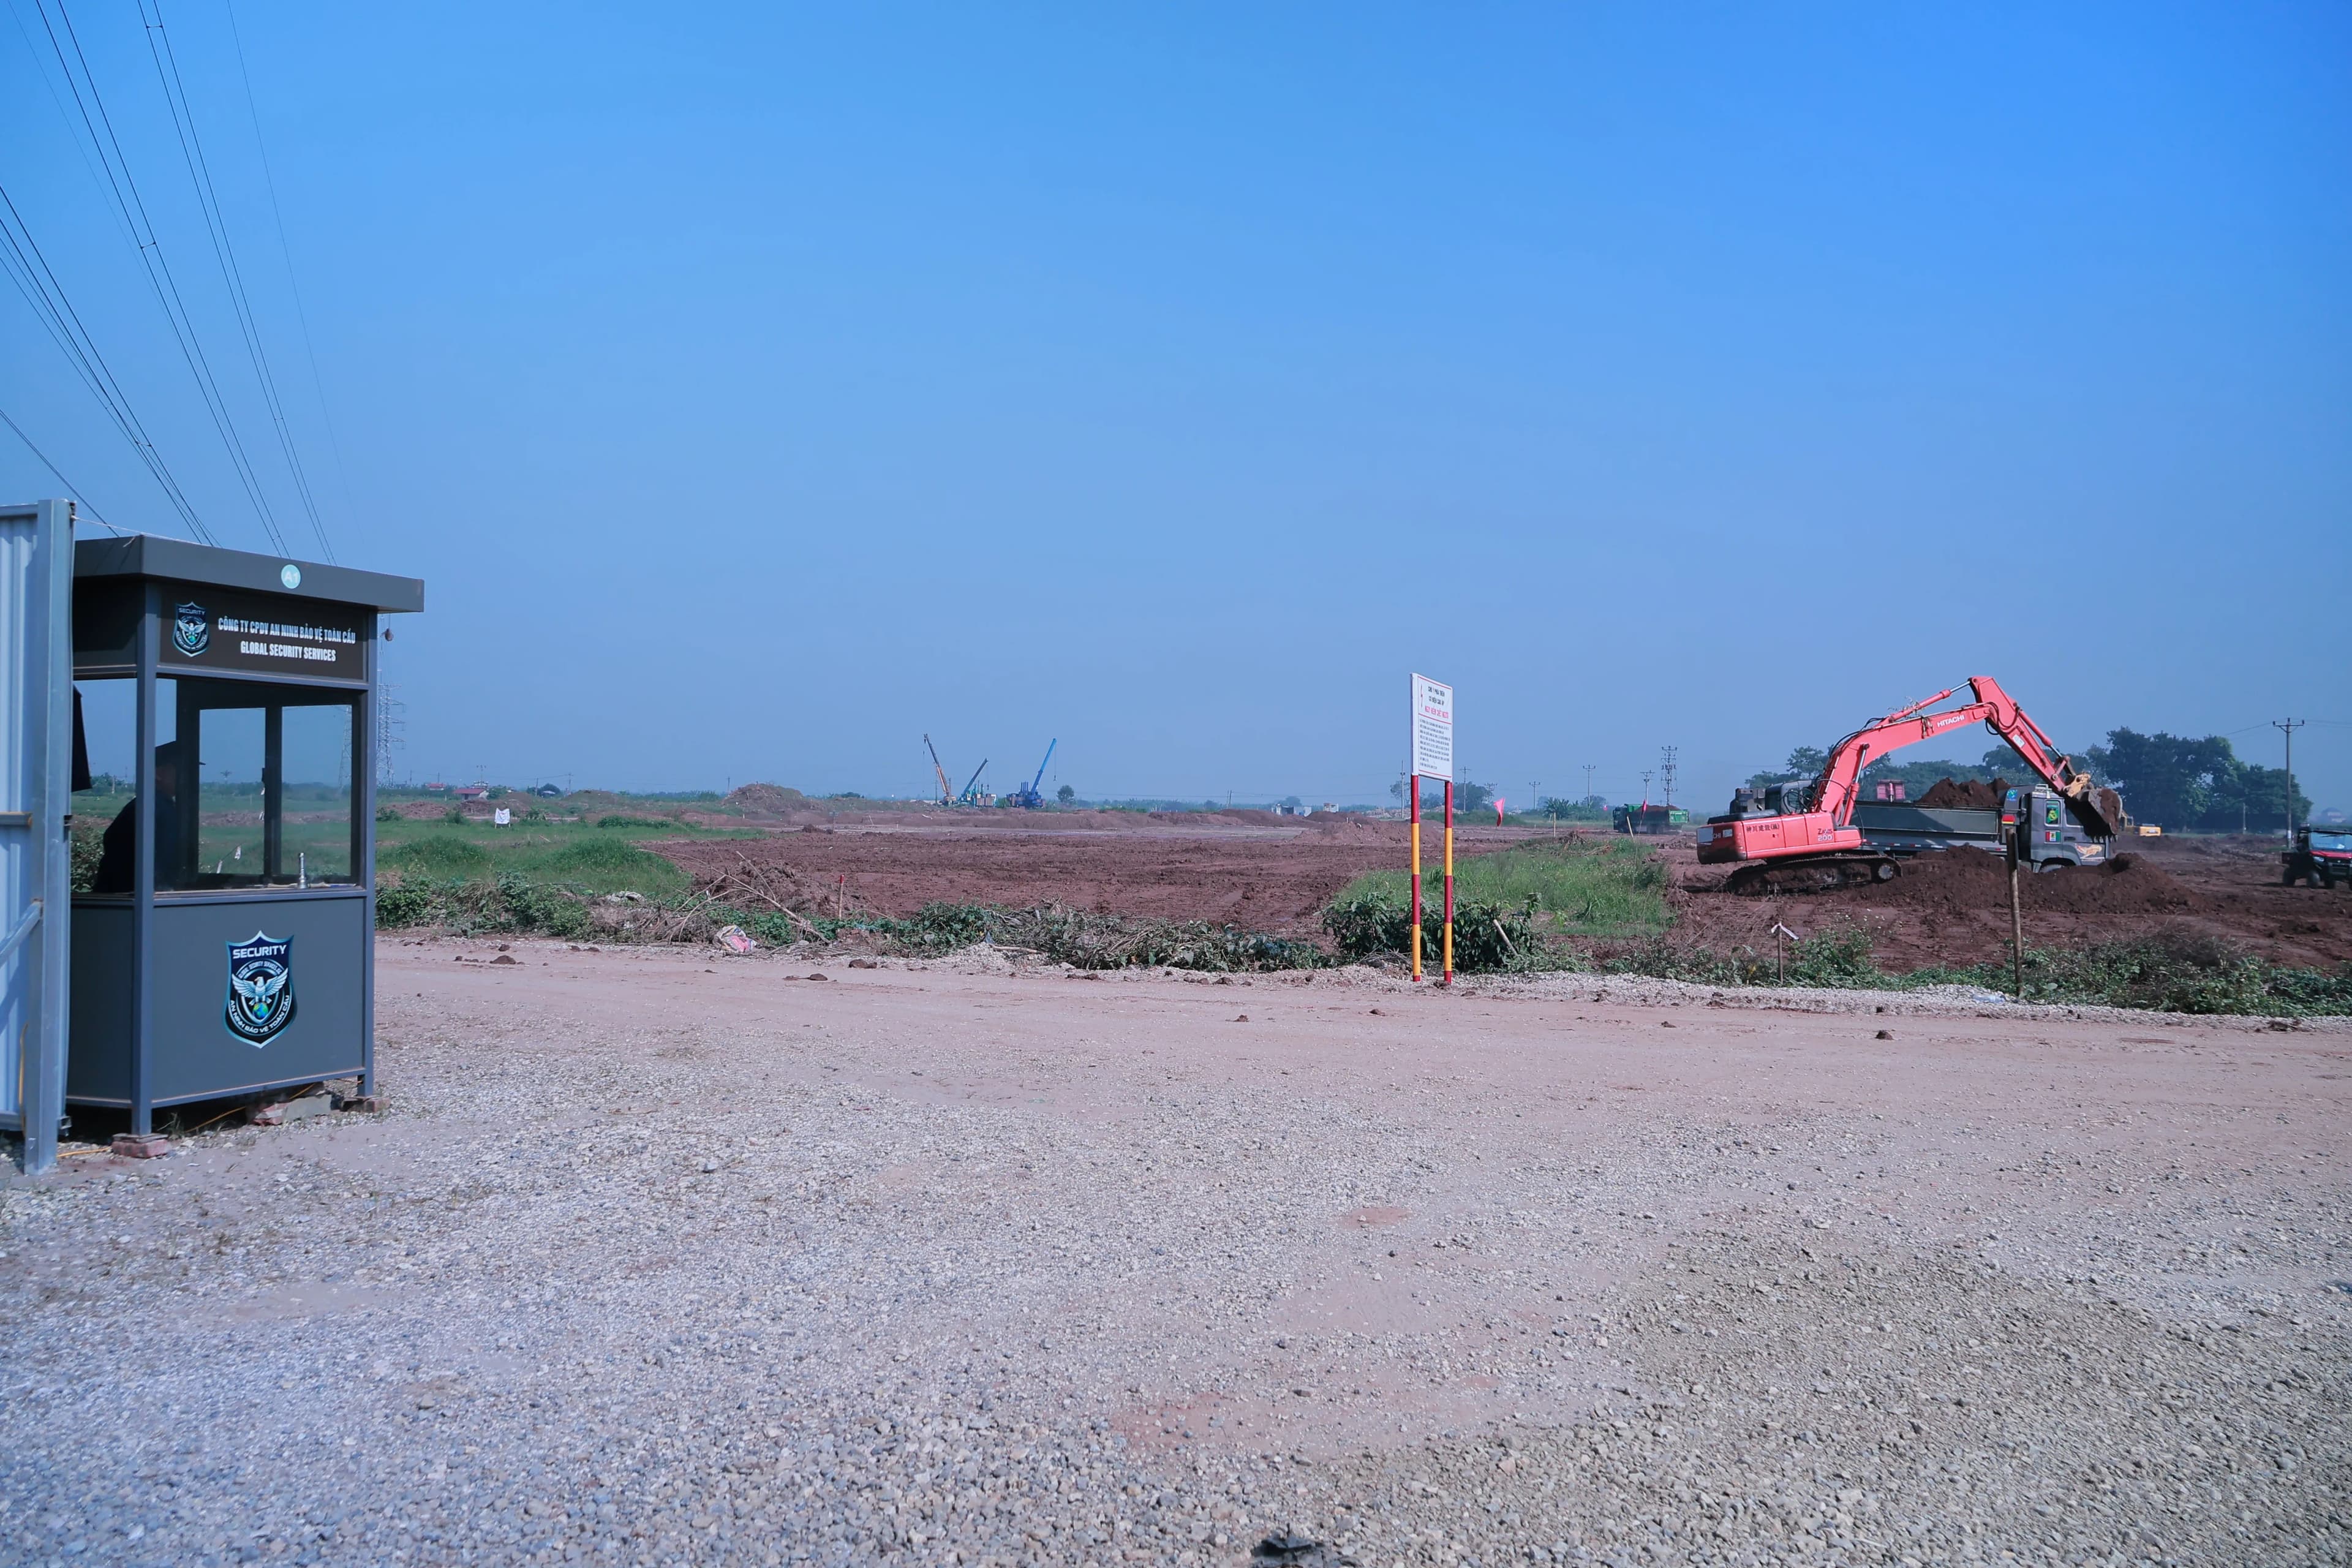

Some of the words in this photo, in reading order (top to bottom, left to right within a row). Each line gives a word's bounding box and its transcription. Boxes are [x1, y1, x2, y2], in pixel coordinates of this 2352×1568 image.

[284, 571, 299, 584] A1
[218, 616, 239, 632] CÔNG
[240, 620, 249, 633] TY
[250, 621, 269, 635] CPDV
[270, 623, 280, 636] AN
[281, 624, 299, 638] NINH
[300, 623, 314, 640] BẢO
[314, 626, 323, 643] VỆ
[324, 627, 341, 643] TOÀN
[241, 640, 268, 655] GLOBAL
[270, 643, 303, 659] SECURITY
[304, 647, 336, 662] SERVICES
[1937, 714, 1966, 728] HITACHI
[233, 944, 287, 959] SECURITY
[230, 1000, 236, 1012] AN
